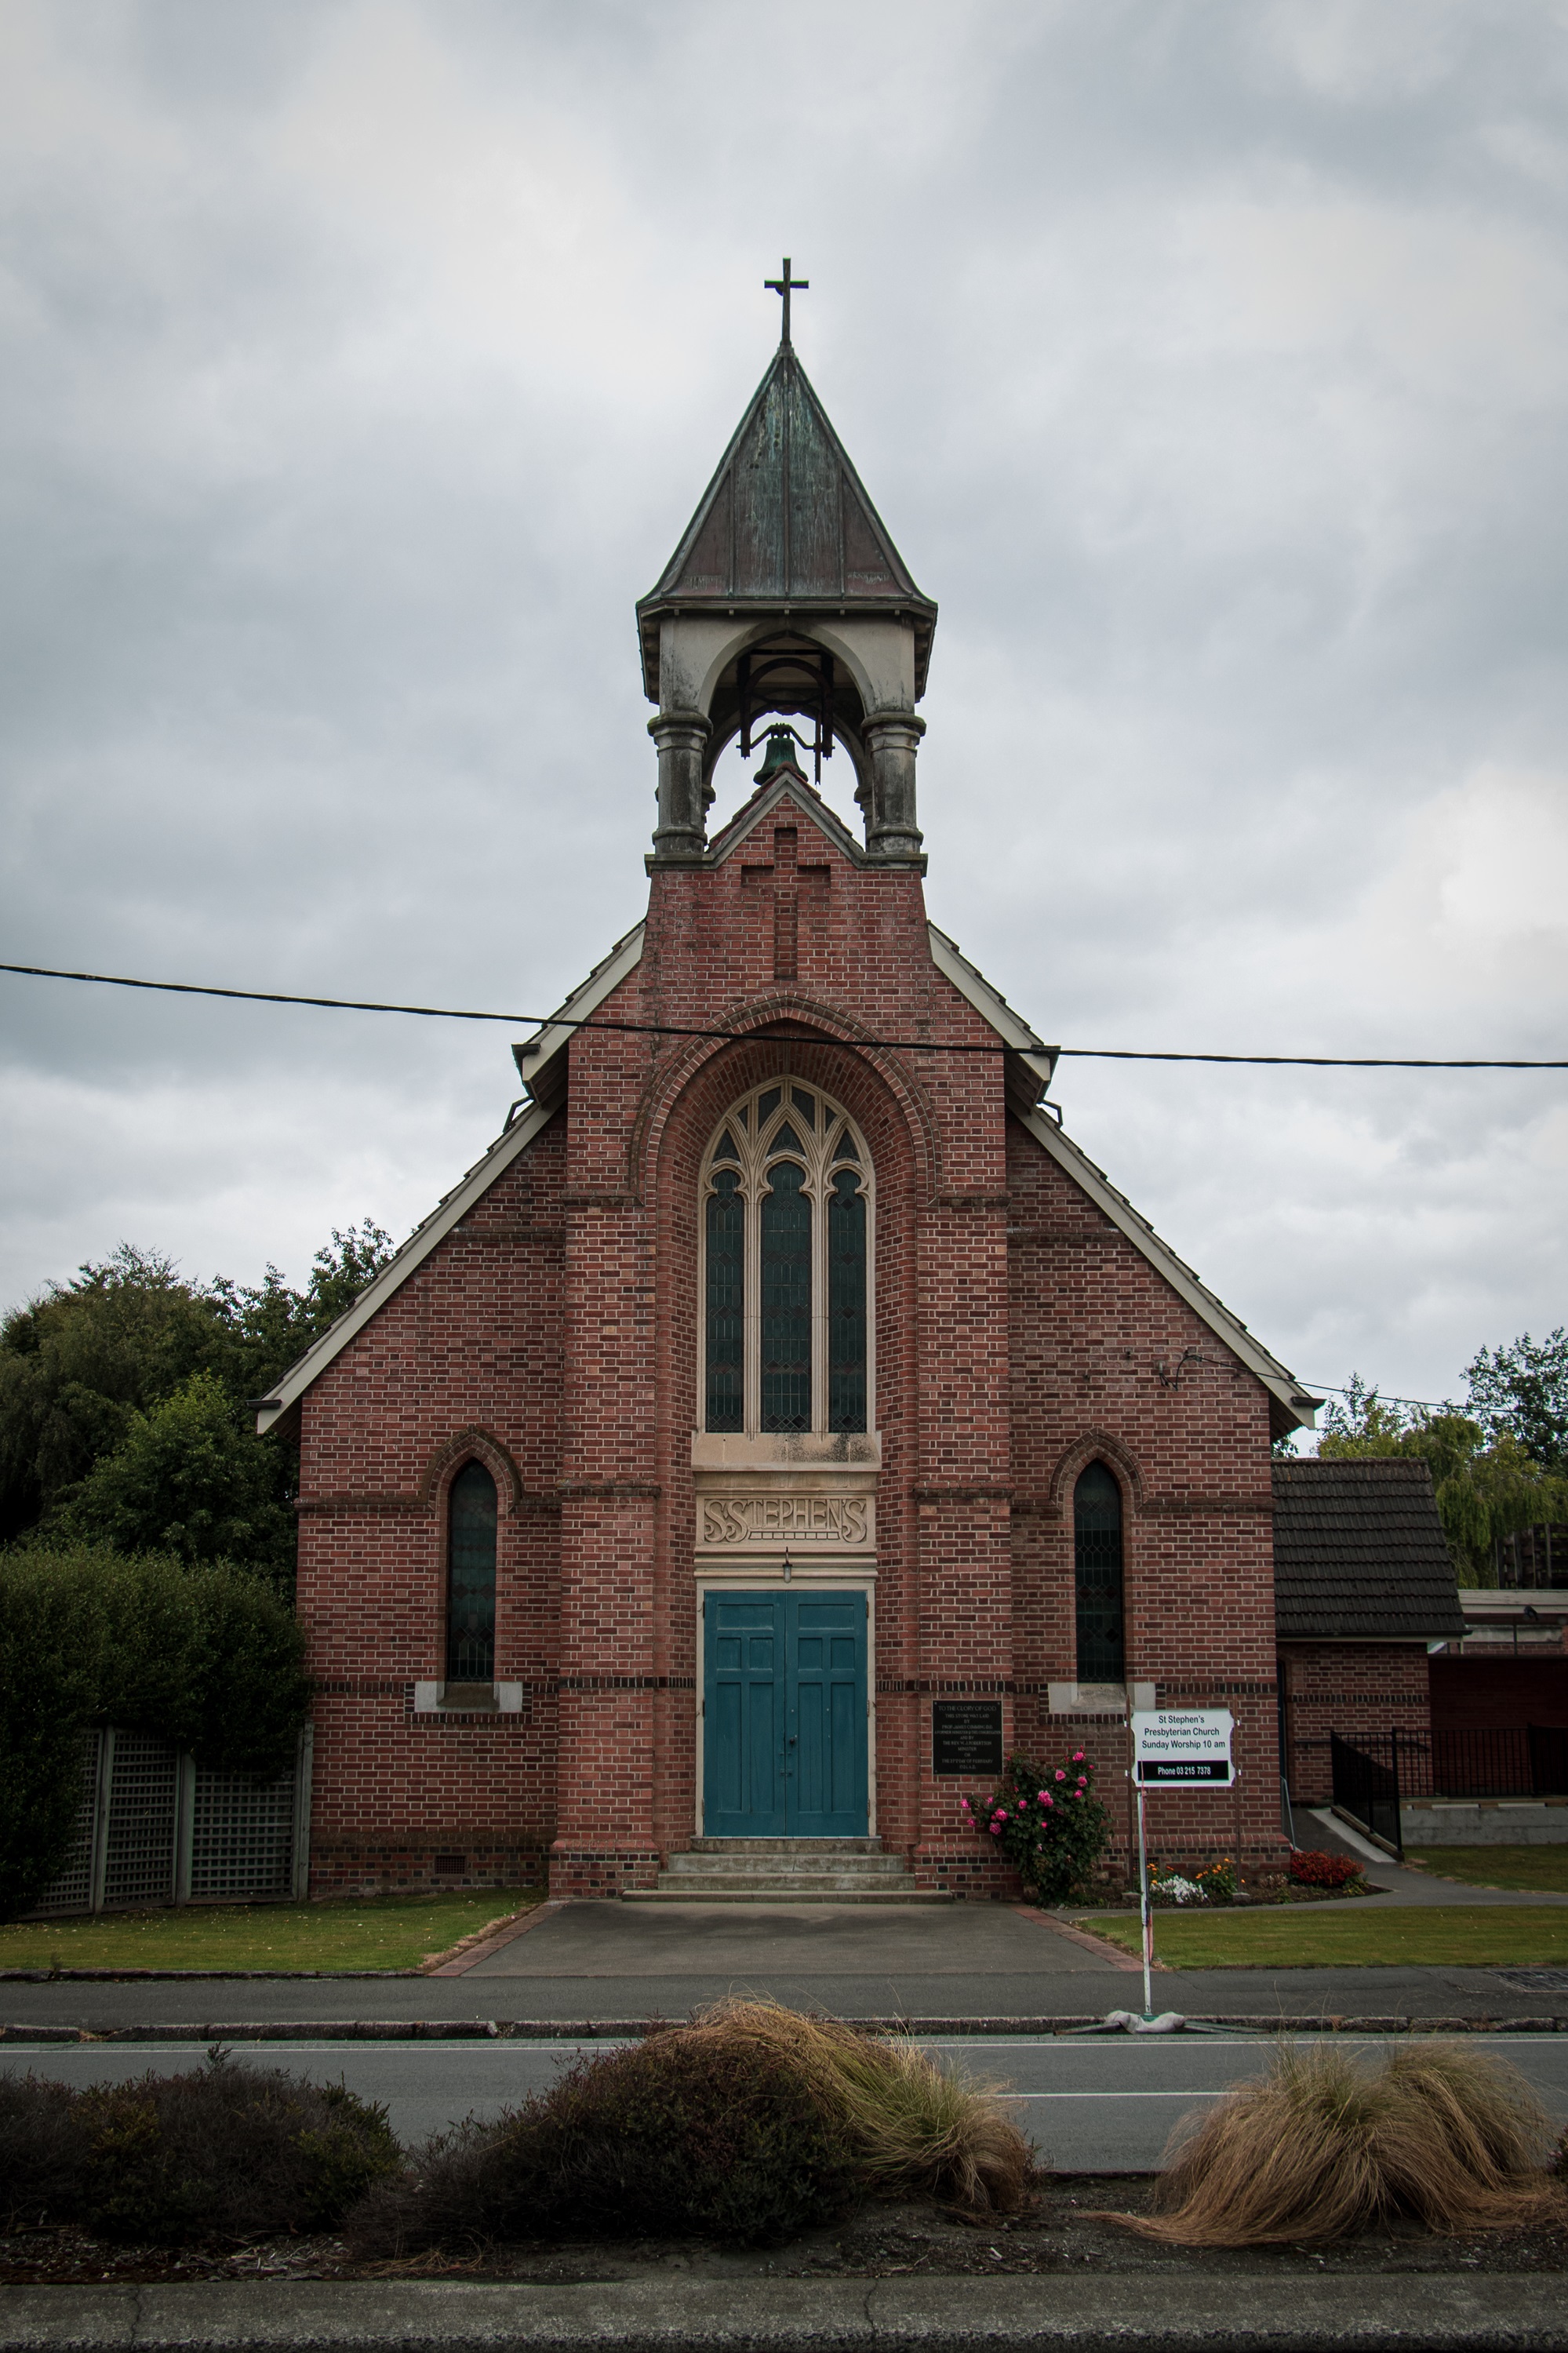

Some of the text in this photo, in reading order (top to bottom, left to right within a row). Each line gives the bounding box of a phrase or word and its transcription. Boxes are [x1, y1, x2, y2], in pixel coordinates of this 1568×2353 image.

[1159, 1715, 1205, 1725] St Stephen's
[1144, 1727, 1220, 1737] Presbyterian Church
[1142, 1740, 1169, 1750] Sunday
[1170, 1740, 1201, 1750] Worship
[1202, 1740, 1212, 1748] 10
[1158, 1766, 1211, 1775] Phone 03 215 7378
